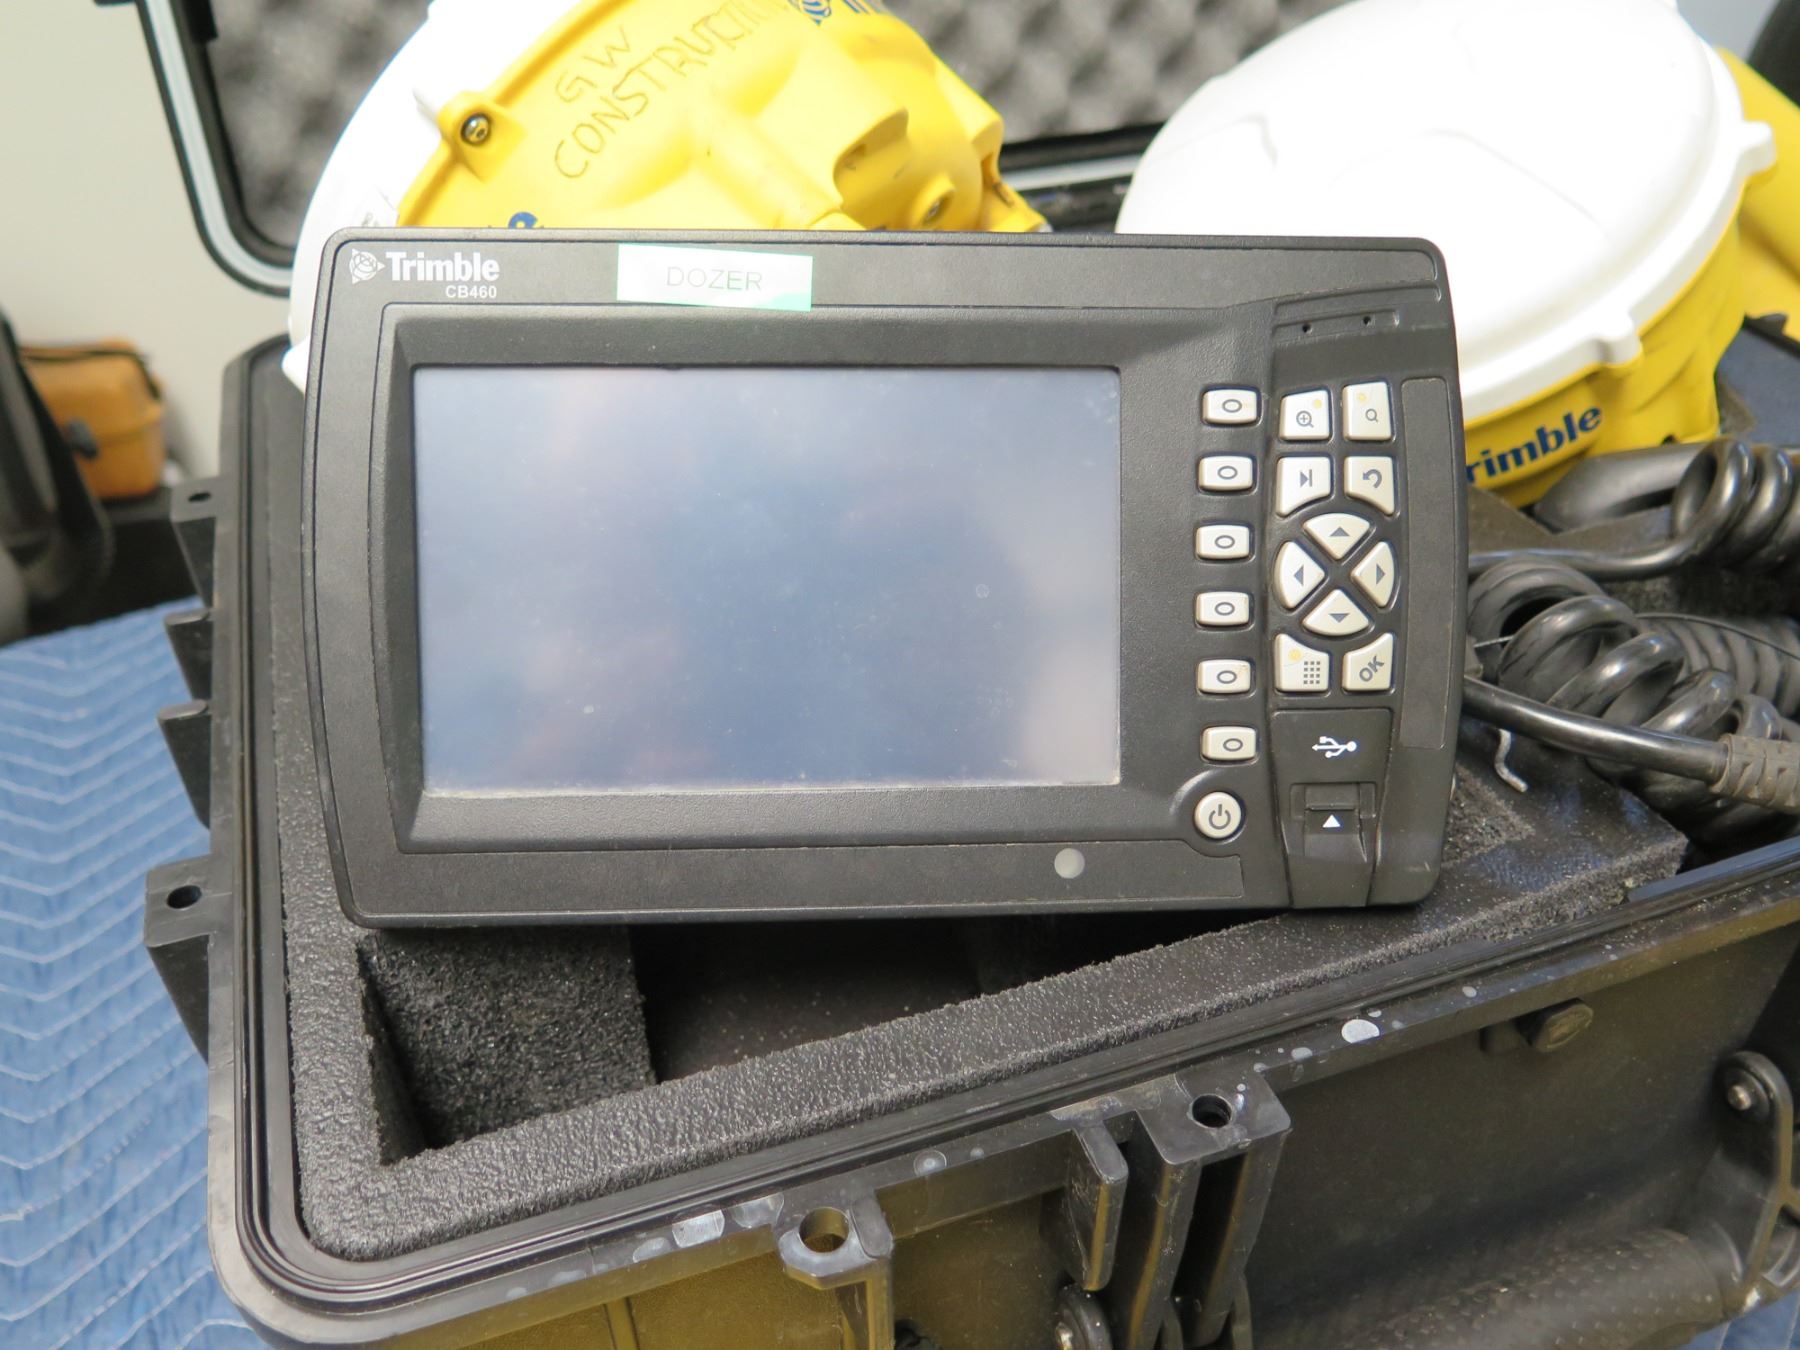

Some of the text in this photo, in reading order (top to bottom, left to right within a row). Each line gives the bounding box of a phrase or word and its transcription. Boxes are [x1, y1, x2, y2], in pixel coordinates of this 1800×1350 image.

[385, 251, 500, 282] Trimble
[666, 266, 763, 290] DOZER
[445, 285, 497, 299] CB460
[1465, 407, 1601, 483] rimble
[1359, 656, 1385, 682] OK
